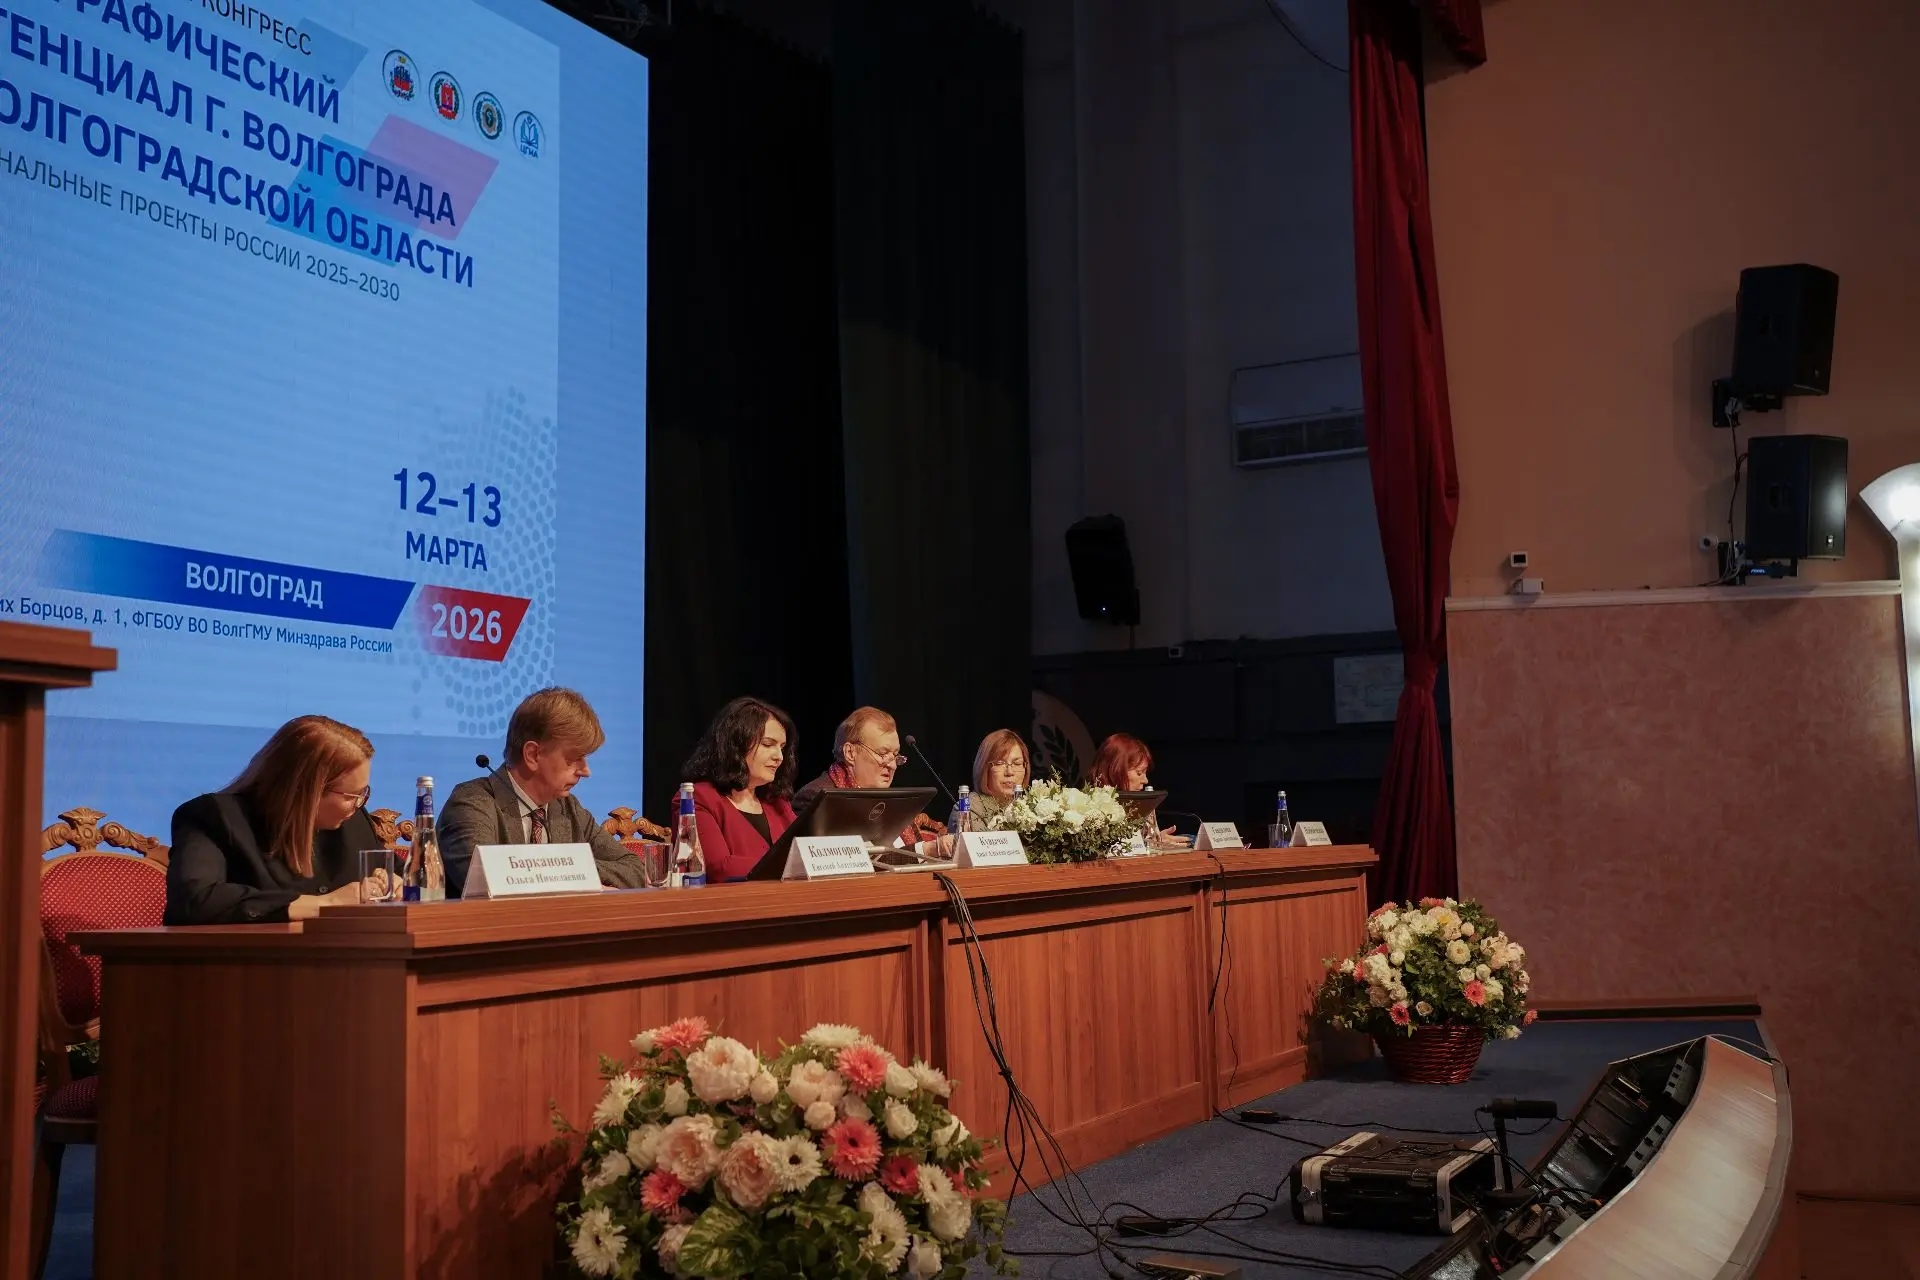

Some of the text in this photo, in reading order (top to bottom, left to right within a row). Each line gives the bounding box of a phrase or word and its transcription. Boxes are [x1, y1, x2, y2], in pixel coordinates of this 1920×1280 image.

[0, 7, 456, 227] ЕНЦИАЛ Г. ВОЛГОГРАДА
[0, 79, 474, 288] ОЛГОГРАДСКОЙ ОБЛАСТИ
[120, 189, 218, 243] ПРОЕКТЫ
[224, 226, 301, 271] РОССИИ
[405, 530, 488, 572] МАРТА
[185, 561, 324, 610] ВОЛГОГРАД
[20, 597, 88, 624] Борцов,
[92, 609, 107, 625] д.
[113, 608, 127, 628] 1,
[132, 609, 184, 631] ФГБОУ
[188, 616, 208, 634] ВО
[212, 619, 273, 641] ВолгГМУ
[276, 627, 347, 650] Минздрава
[350, 634, 392, 653] России
[431, 602, 502, 645] 2026
[508, 856, 575, 872] Барканова
